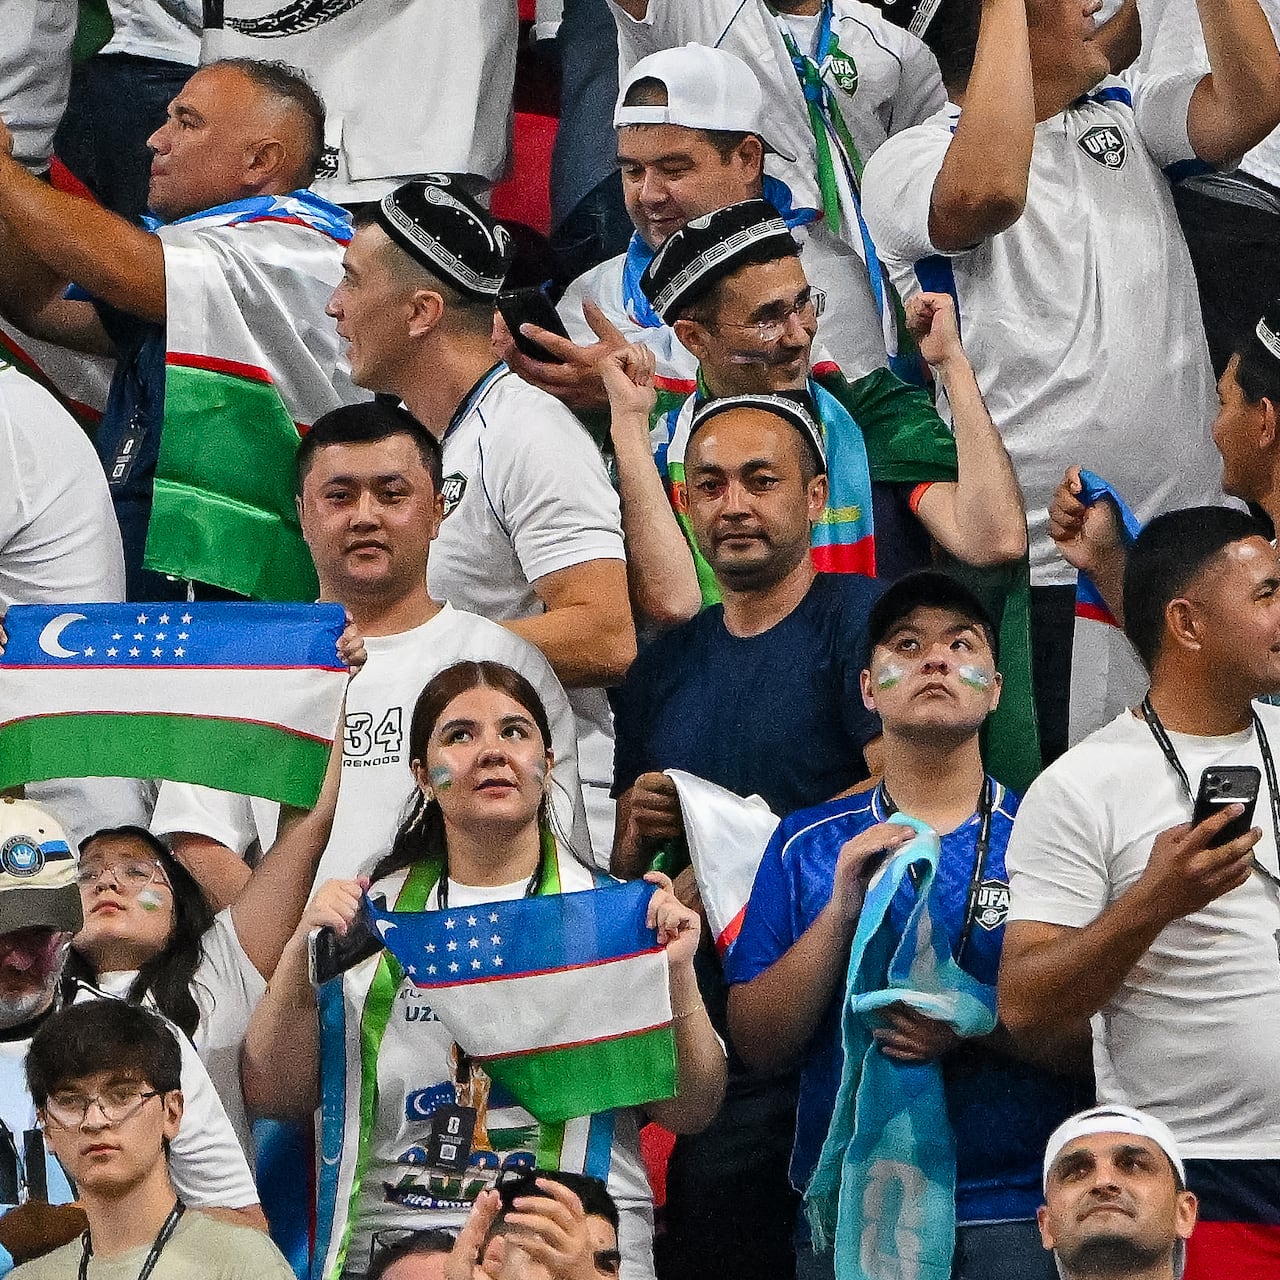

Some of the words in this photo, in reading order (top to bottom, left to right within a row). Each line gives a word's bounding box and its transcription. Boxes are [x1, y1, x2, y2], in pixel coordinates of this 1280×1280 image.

[830, 59, 854, 75] UFA
[1084, 131, 1121, 154] UFA
[342, 706, 403, 757] 34
[977, 889, 1009, 908] UFA
